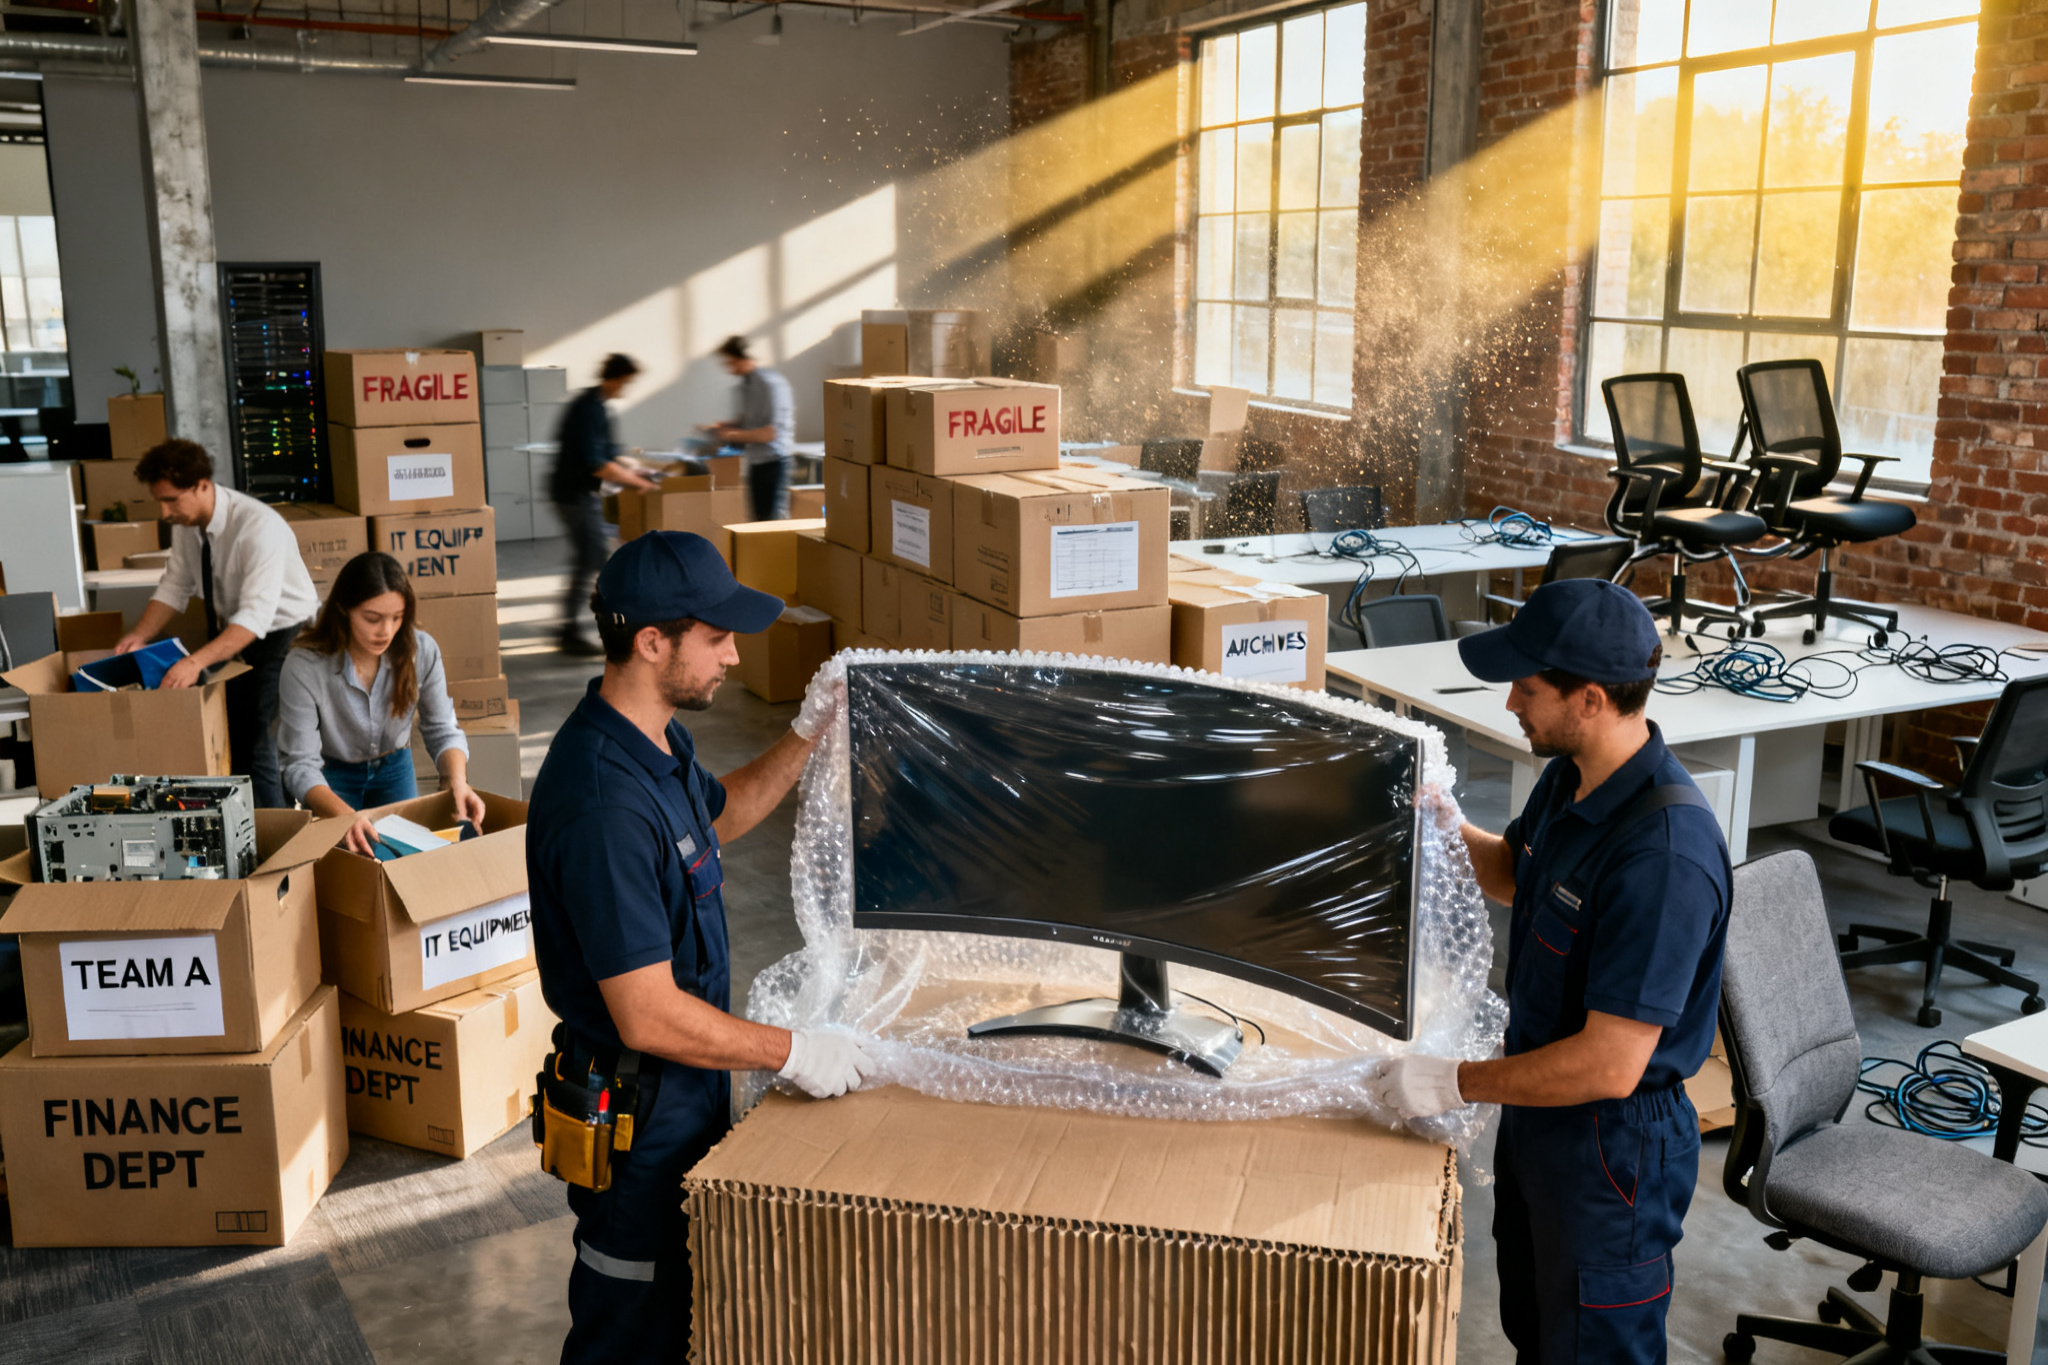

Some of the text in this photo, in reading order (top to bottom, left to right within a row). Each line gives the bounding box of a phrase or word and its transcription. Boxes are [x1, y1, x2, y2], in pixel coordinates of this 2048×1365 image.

[363, 373, 469, 403] FRAGILE
[948, 405, 1046, 439] FRAGILE
[390, 531, 407, 552] IT
[408, 554, 460, 577] ENT
[425, 933, 442, 958] IT
[71, 956, 212, 990] TEAM A
[341, 1026, 443, 1071] INANCE
[345, 1064, 420, 1104] DEPT
[44, 1096, 242, 1138] FINANCE
[83, 1150, 205, 1190] DEPT
